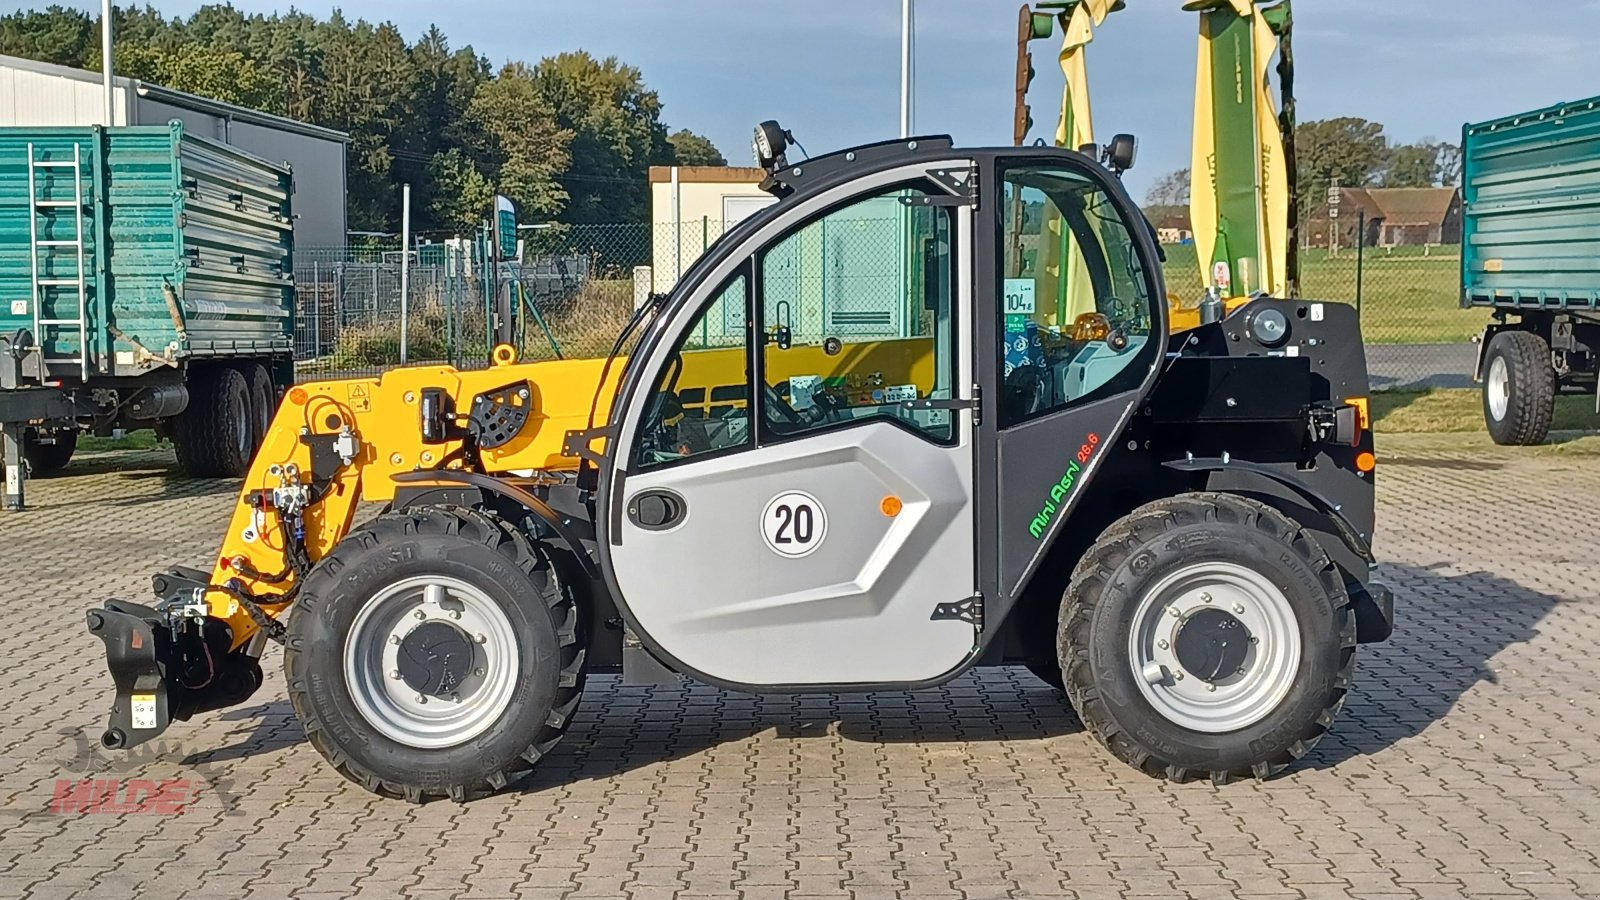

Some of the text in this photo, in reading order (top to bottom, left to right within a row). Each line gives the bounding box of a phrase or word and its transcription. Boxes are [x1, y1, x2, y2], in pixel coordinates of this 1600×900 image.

[1006, 294, 1026, 310] 104
[1078, 433, 1099, 463] 26.6
[775, 504, 813, 543] 20
